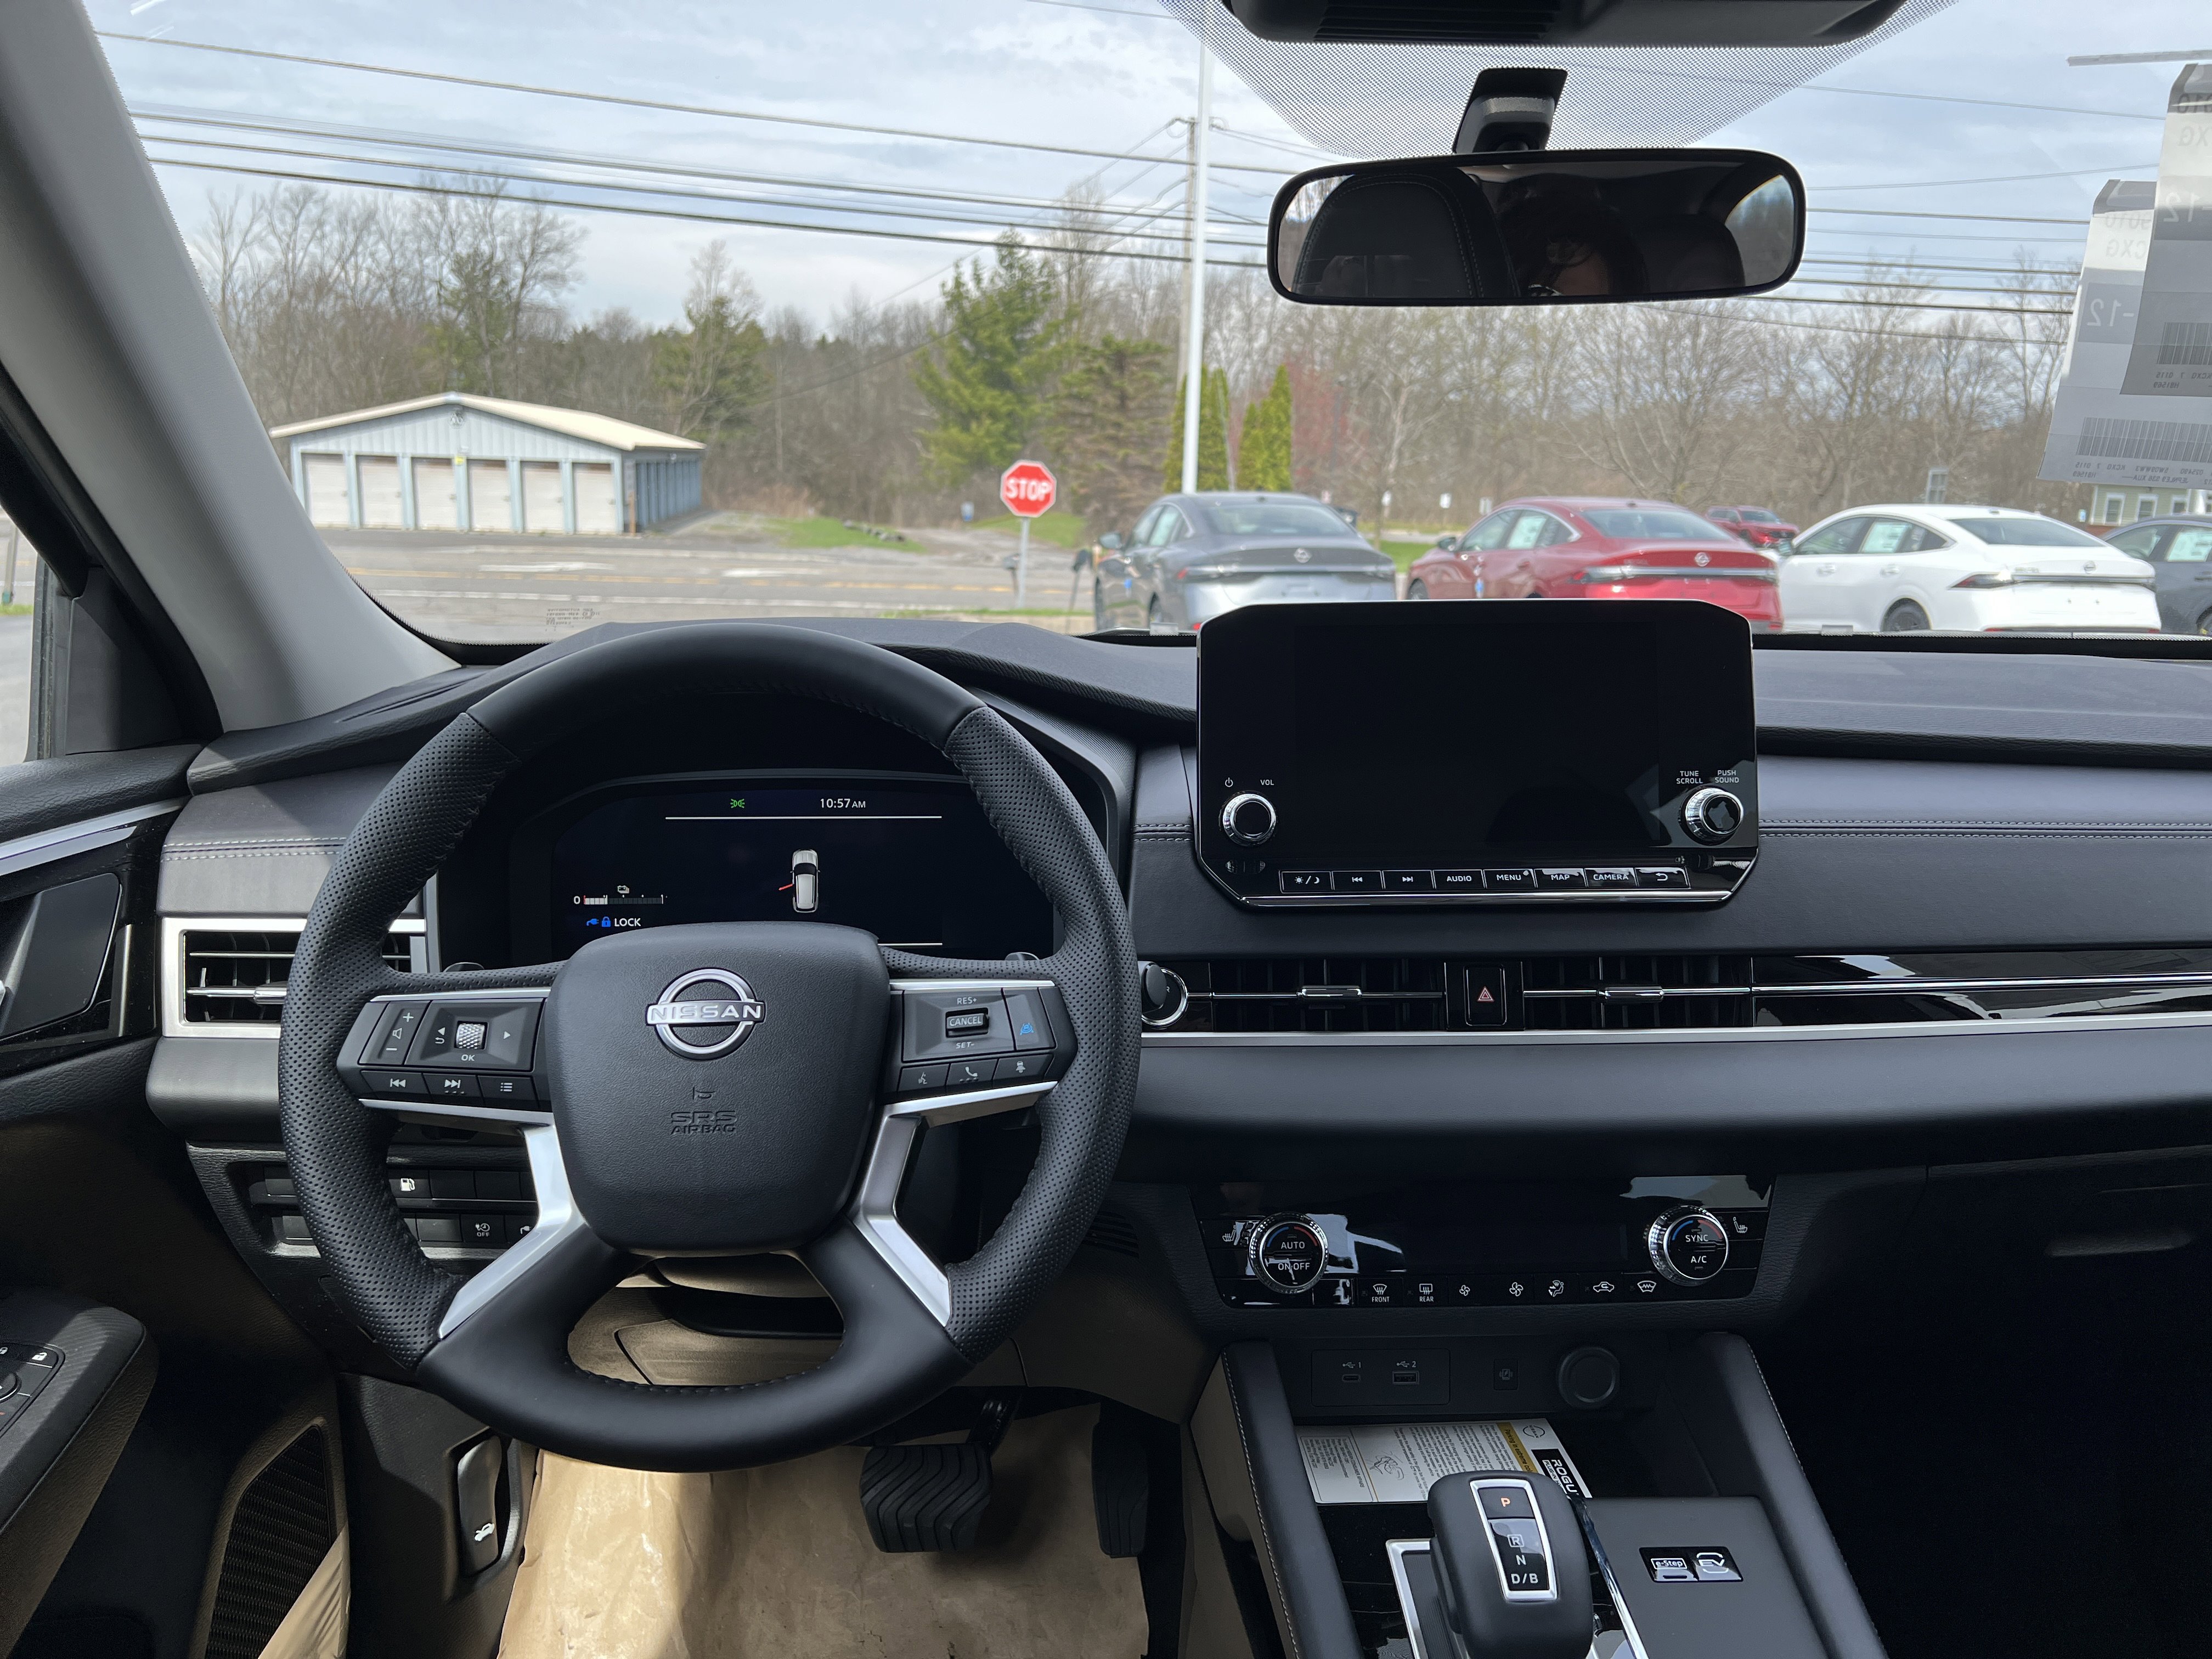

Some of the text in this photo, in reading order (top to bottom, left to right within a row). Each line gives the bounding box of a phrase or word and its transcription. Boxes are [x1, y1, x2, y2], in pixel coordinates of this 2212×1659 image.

[1006, 478, 1053, 501] STOP
[614, 918, 641, 927] LOCK
[651, 1004, 761, 1021] NISSAN
[949, 1016, 982, 1026] CANCEL
[670, 1110, 737, 1124] SRS
[670, 1125, 737, 1135] AIRBAG
[1685, 1234, 1709, 1243] SYNC
[1280, 1241, 1305, 1249] AUTO
[1528, 1425, 1539, 1438] NISSAN
[1551, 1459, 1579, 1496] ROGU
[1500, 1497, 1510, 1508] P
[1511, 1536, 1521, 1545] R
[1516, 1554, 1526, 1565] N
[1698, 1559, 1725, 1567] EV
